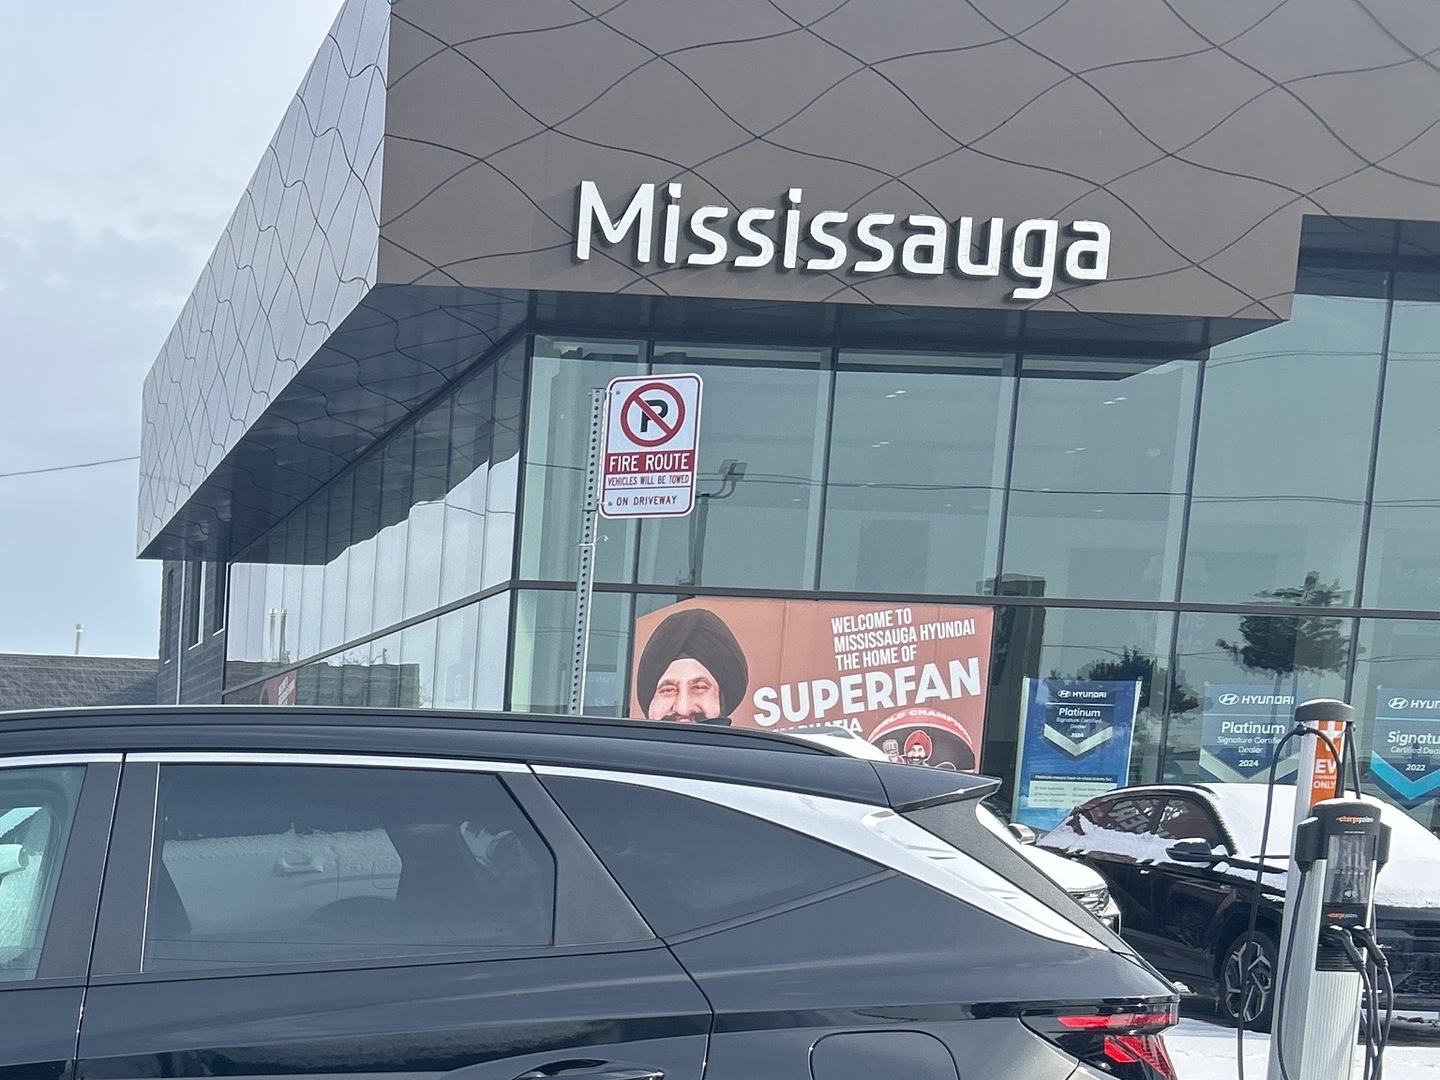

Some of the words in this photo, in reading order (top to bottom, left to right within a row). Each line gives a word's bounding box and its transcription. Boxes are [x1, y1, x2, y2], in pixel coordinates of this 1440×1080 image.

[576, 180, 1112, 301] Mississauga
[609, 454, 639, 472] FIRE
[645, 453, 690, 471] ROUTE
[607, 476, 638, 487] VEHICLES
[640, 475, 654, 486] WILL
[657, 475, 666, 485] BE
[669, 474, 690, 484] TOWED
[616, 497, 628, 506] ON
[633, 495, 678, 506] DRIVEWAY
[831, 610, 894, 635] WELCOME
[896, 607, 912, 626] TO
[834, 626, 918, 653] MISSISSAUGA
[920, 618, 976, 641] HYUNDAI
[835, 653, 861, 671] THE
[863, 647, 899, 668] HOME
[901, 644, 917, 662] OF
[753, 656, 982, 728] SUPERFAN
[1241, 695, 1295, 705] HYUNDAI
[1059, 708, 1101, 717] Platinum
[1221, 721, 1285, 735] Platinum
[1217, 736, 1252, 745] Signature
[1254, 736, 1282, 744] Certifie
[1391, 746, 1421, 754] Certified
[1315, 758, 1337, 774] EV
[1314, 780, 1336, 789] ONLY
